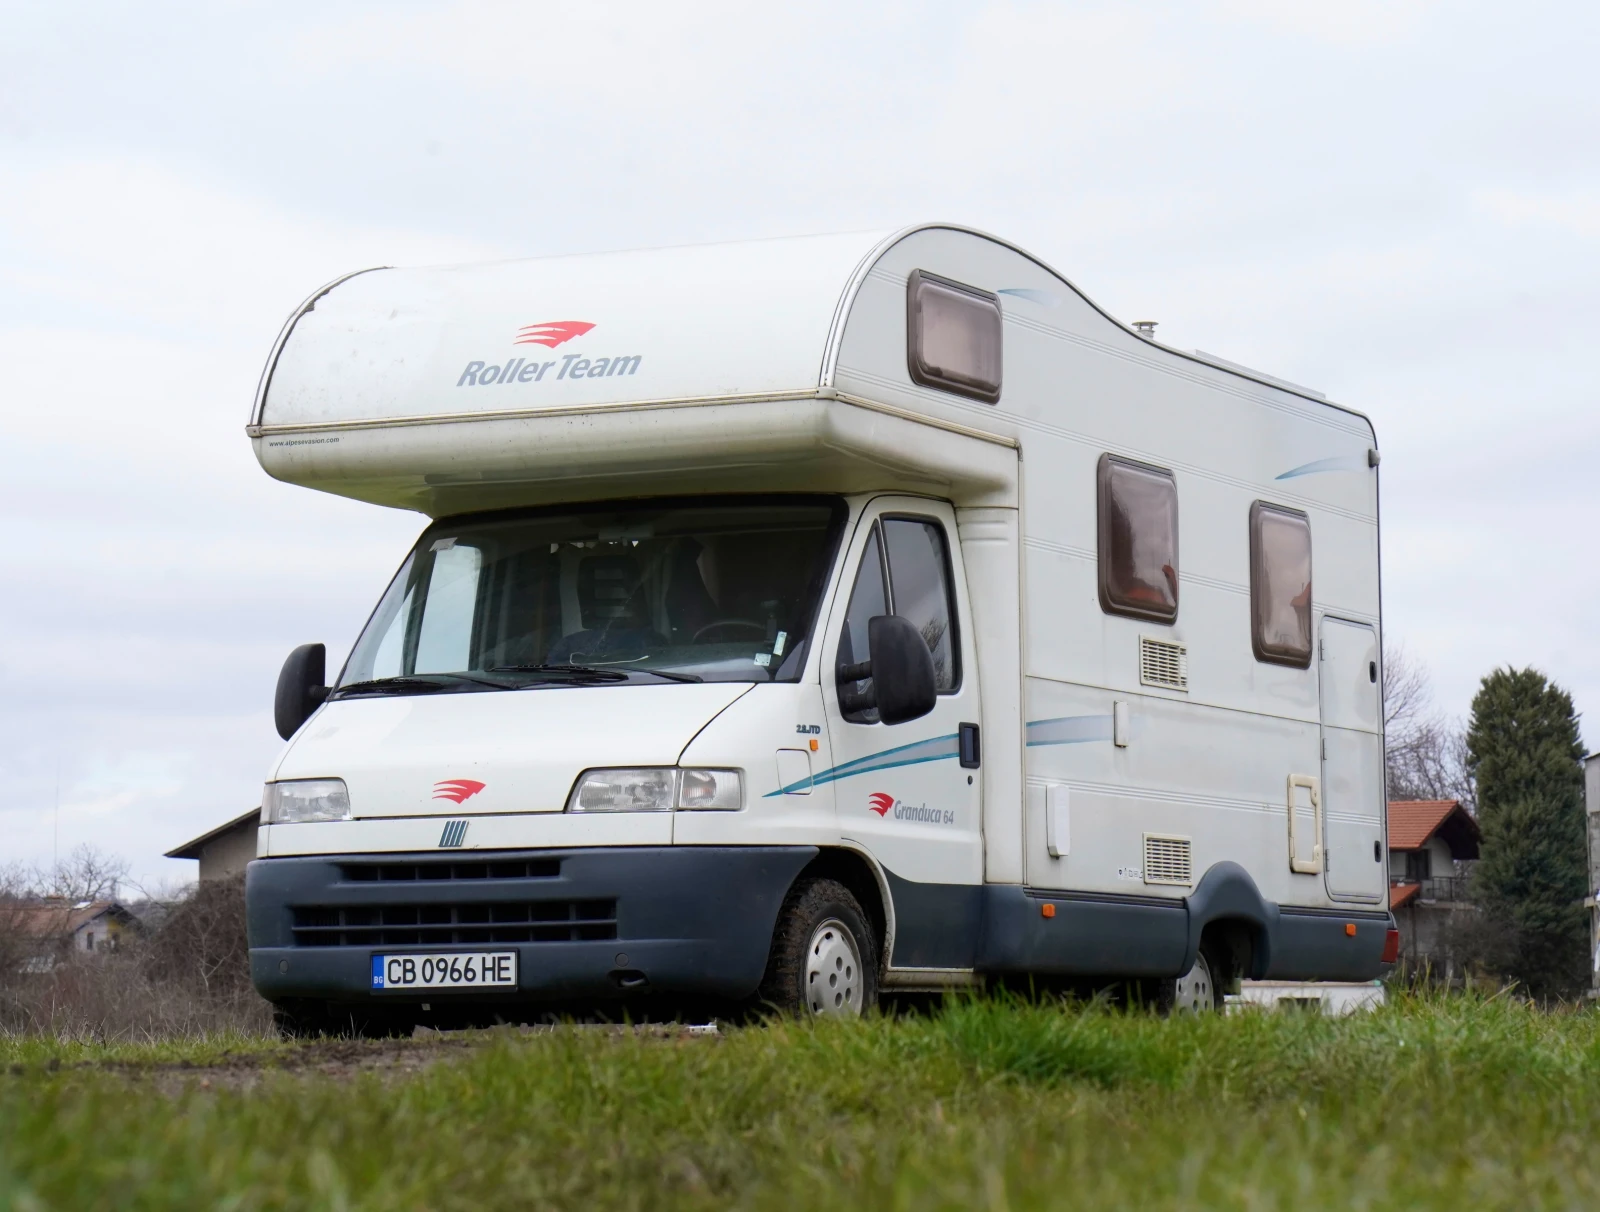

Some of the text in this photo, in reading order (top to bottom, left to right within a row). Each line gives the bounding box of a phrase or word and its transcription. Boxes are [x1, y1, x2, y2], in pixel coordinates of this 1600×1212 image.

[456, 353, 643, 387] Roller Team
[269, 437, 340, 447] www.alpesevasion.com
[894, 800, 955, 824] Granduca 64
[373, 976, 384, 984] BG
[387, 956, 512, 984] CB 0966 HE
